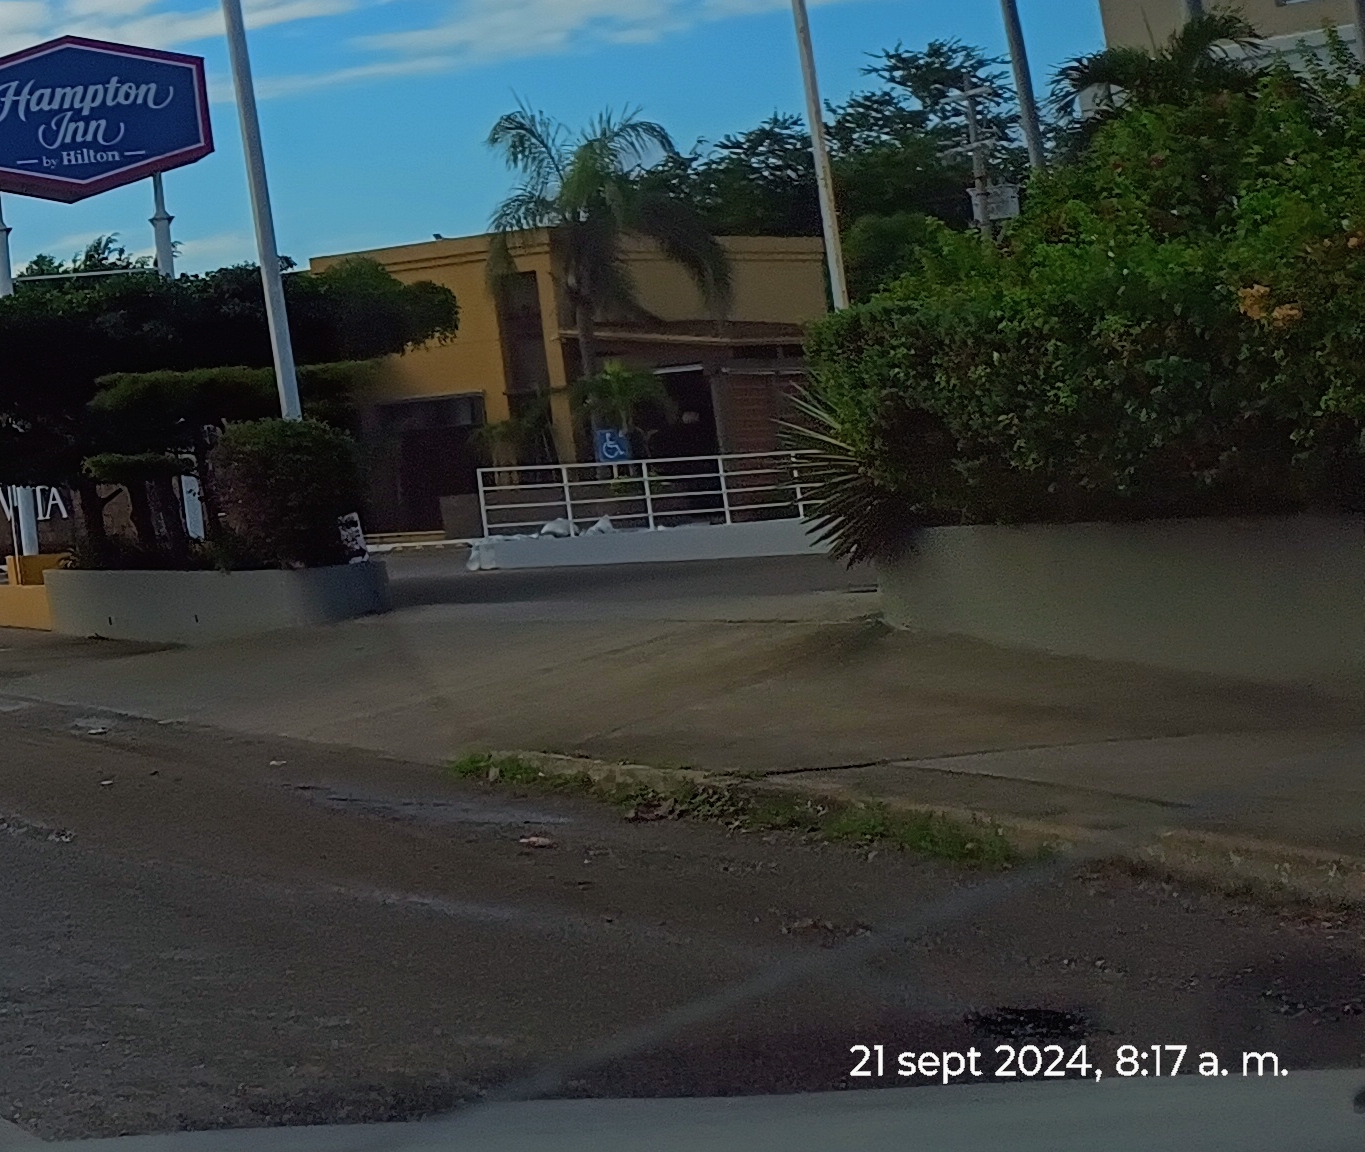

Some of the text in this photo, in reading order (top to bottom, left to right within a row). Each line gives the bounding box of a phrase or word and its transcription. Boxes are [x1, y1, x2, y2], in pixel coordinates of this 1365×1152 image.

[38, 111, 125, 149] Inn
[42, 148, 120, 169] by Hilton
